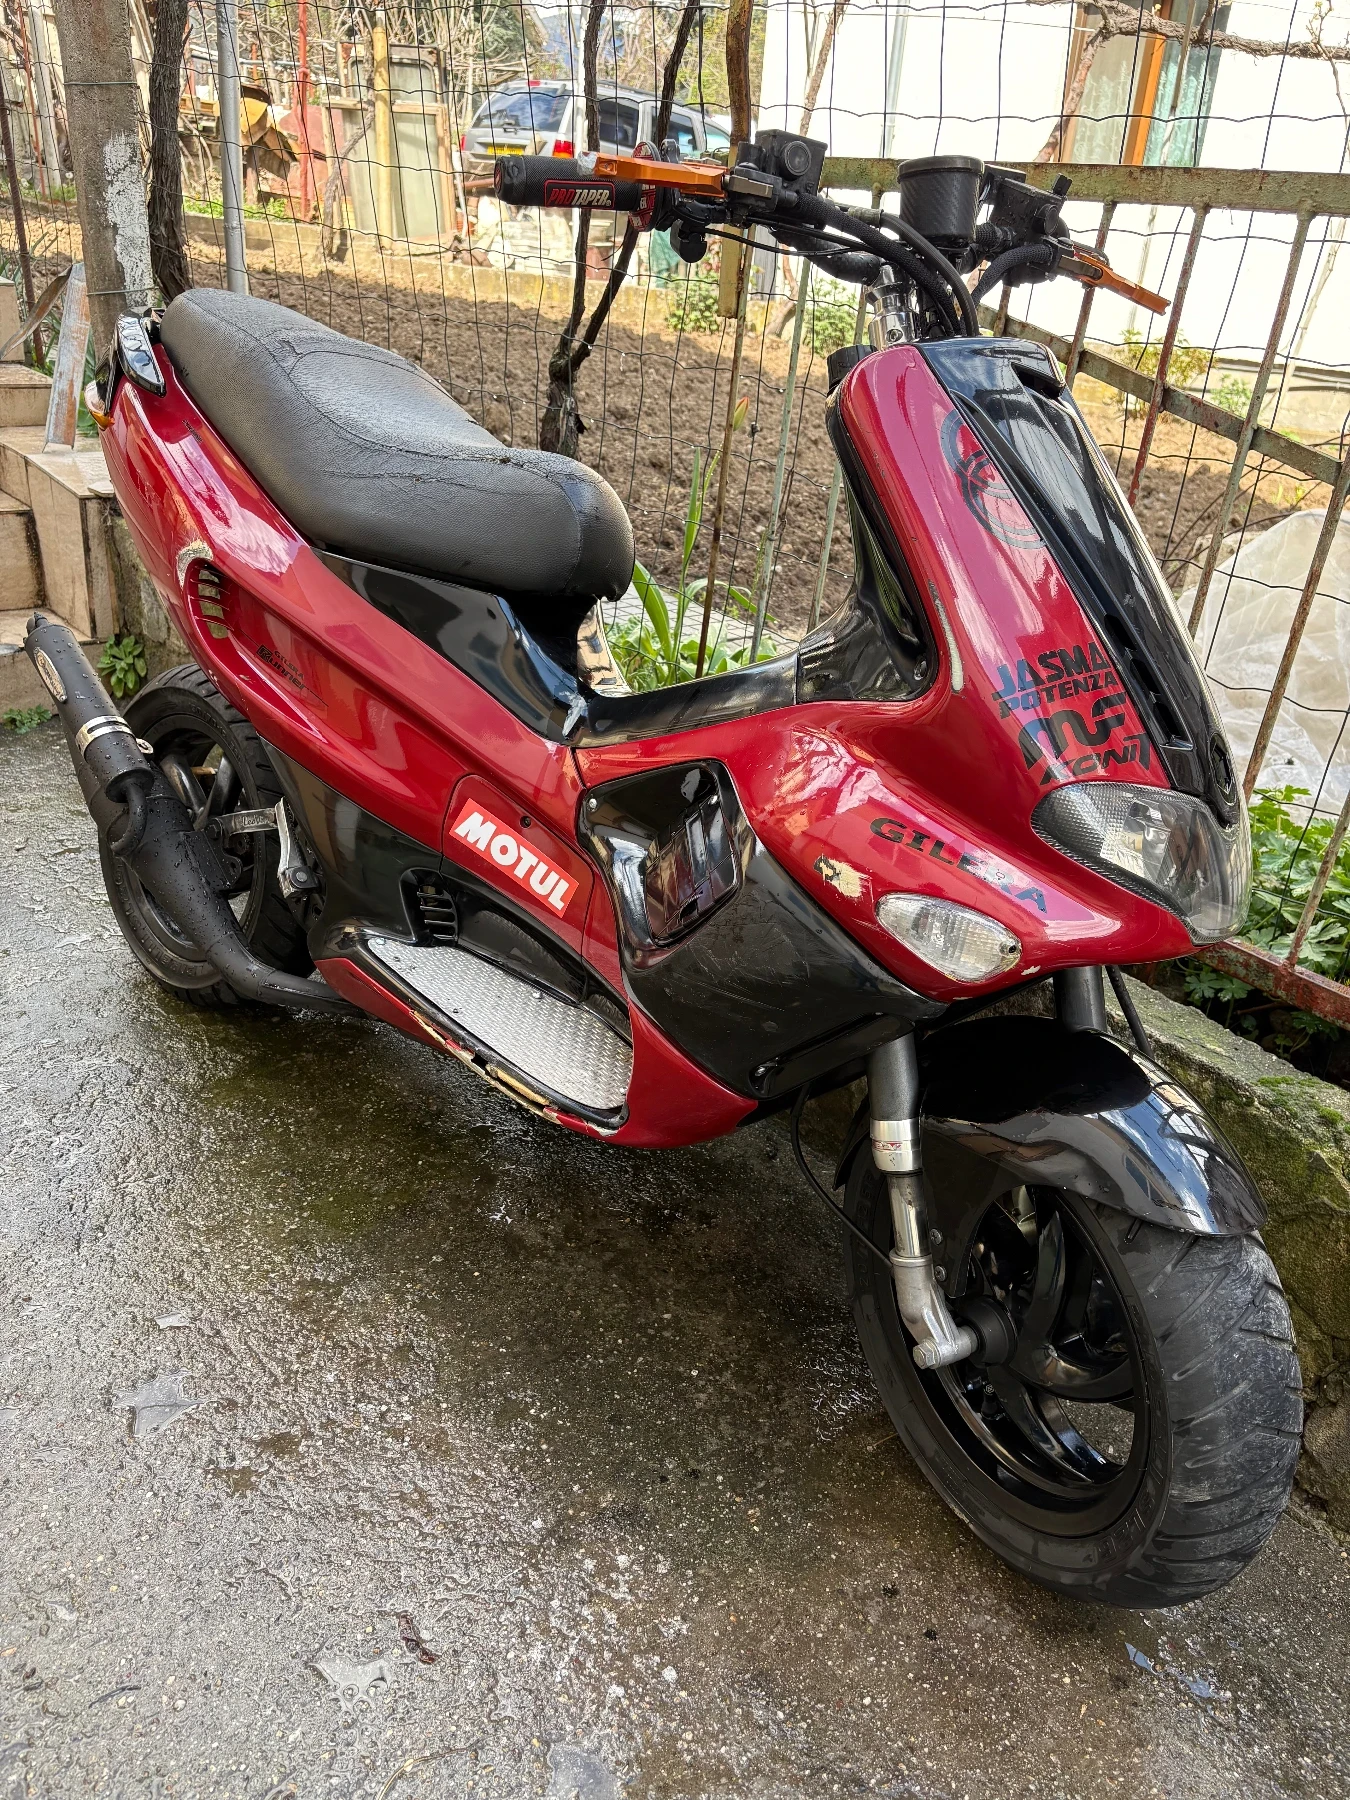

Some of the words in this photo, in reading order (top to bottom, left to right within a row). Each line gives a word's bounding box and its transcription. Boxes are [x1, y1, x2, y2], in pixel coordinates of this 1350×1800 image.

[257, 645, 305, 690] Runner
[992, 641, 1111, 700] JASMA
[998, 671, 1119, 719] POTENZA
[1039, 740, 1143, 785] KONI
[454, 811, 570, 911] MOTUL
